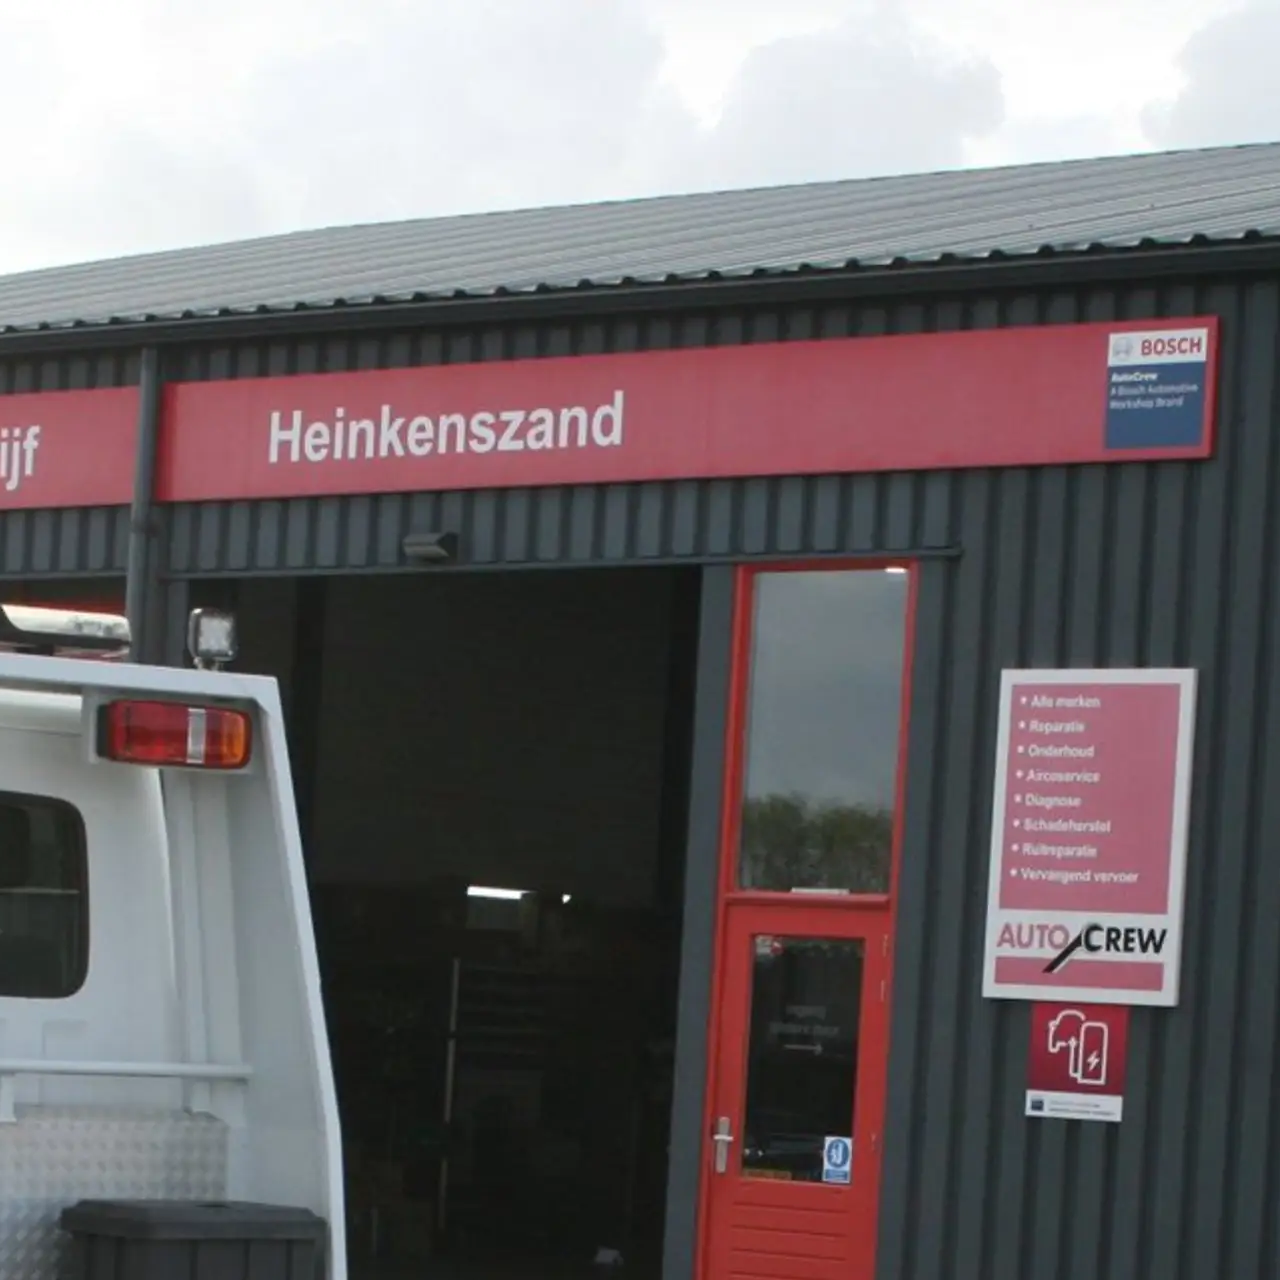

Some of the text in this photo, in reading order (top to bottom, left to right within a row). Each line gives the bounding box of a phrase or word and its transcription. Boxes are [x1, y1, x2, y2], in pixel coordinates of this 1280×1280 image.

[1141, 337, 1202, 356] BOSCH
[269, 390, 624, 463] Heinkenszand
[1029, 720, 1085, 735] Reparatie
[1028, 744, 1095, 757] Onderhoud
[1026, 768, 1100, 783] Aircoservice
[1025, 792, 1081, 810] Diagnose
[1023, 818, 1111, 832] Schadeherstel
[1021, 868, 1139, 884] Vervangend vervoer
